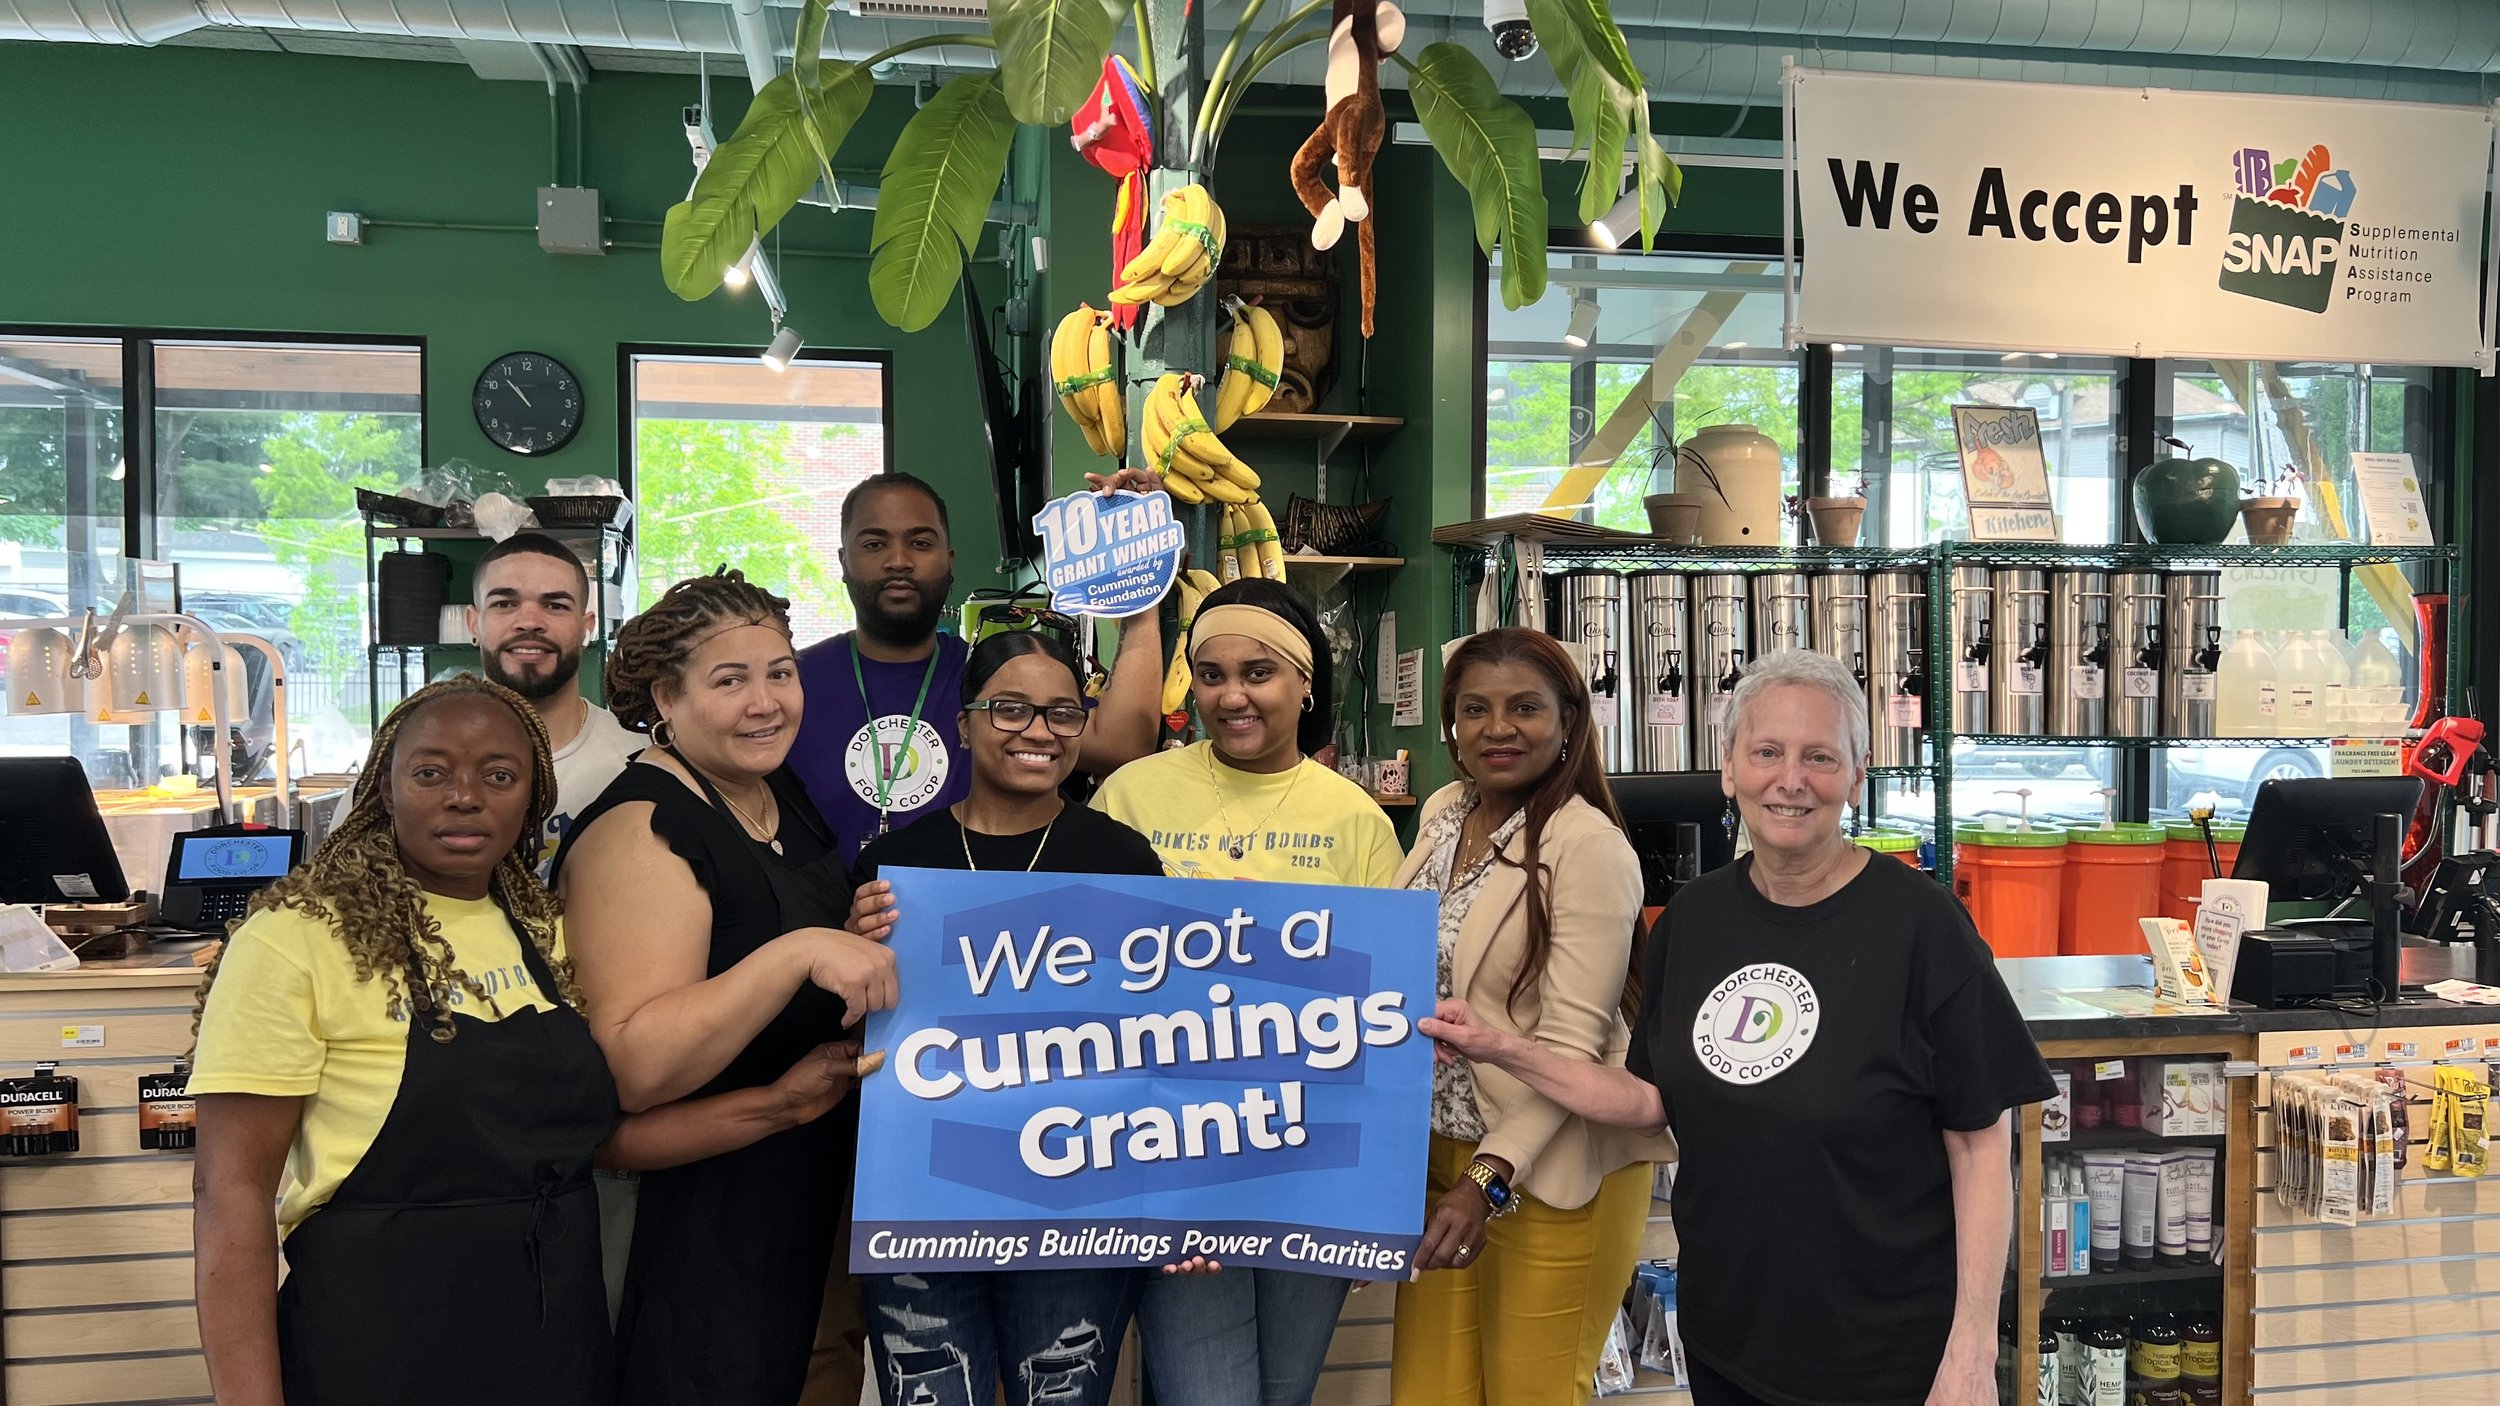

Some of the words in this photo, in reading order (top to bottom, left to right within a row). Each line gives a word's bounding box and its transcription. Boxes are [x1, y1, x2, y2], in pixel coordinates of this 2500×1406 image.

[1827, 158, 1939, 234] We
[1968, 167, 2198, 263] Accept
[2350, 223, 2460, 242] Supplemental
[2222, 232, 2340, 276] SNAP
[2349, 244, 2418, 261] Nutrition
[2347, 266, 2432, 283] Assistance
[2346, 287, 2411, 304] Program
[503, 367, 512, 376] 11
[522, 361, 532, 371] 12
[488, 380, 498, 390] 10
[558, 380, 566, 390] 2
[485, 400, 492, 409] 9
[564, 399, 572, 408] 3
[491, 418, 498, 428] 8
[560, 418, 567, 427] 4
[506, 432, 512, 440] 7
[546, 431, 553, 441] 5
[1963, 410, 2035, 454] Fresh
[526, 437, 533, 446] 6
[1040, 496, 1098, 563] 10
[1099, 498, 1167, 546] YEAR
[1986, 512, 2049, 535] Kitchen
[1052, 552, 1107, 587] GRANT
[1112, 528, 1178, 566] WINNER
[1117, 559, 1149, 577] awarded
[1153, 558, 1164, 571] by
[1088, 571, 1155, 596] Cummings
[1089, 584, 1161, 608] Foundation
[900, 775, 940, 807] CO-OP
[210, 840, 264, 855] DORCHESTER
[1151, 830, 1210, 850] BIKES
[1265, 831, 1335, 850] BOMBS
[1291, 855, 1321, 868] 2023
[958, 925, 1094, 996] We
[1120, 907, 1257, 992] got
[1280, 908, 1332, 959] a
[1712, 967, 1814, 1014] DORCHESTER
[894, 983, 1412, 1099] Cummings
[1698, 1034, 1732, 1074] FOOD
[1739, 1047, 1793, 1079] CO-OP
[0, 1091, 63, 1103] DURACELL
[143, 1088, 185, 1098] DURAC
[1018, 1081, 1309, 1178] Grant!
[867, 1231, 1029, 1265] Cummings
[1039, 1227, 1171, 1261] Buildings
[1181, 1230, 1272, 1257] Power
[1281, 1232, 1407, 1271] Charities
[2140, 1354, 2171, 1366] Tropical
[2184, 1353, 2215, 1364] Tropical
[2100, 1380, 2121, 1388] HEMP
